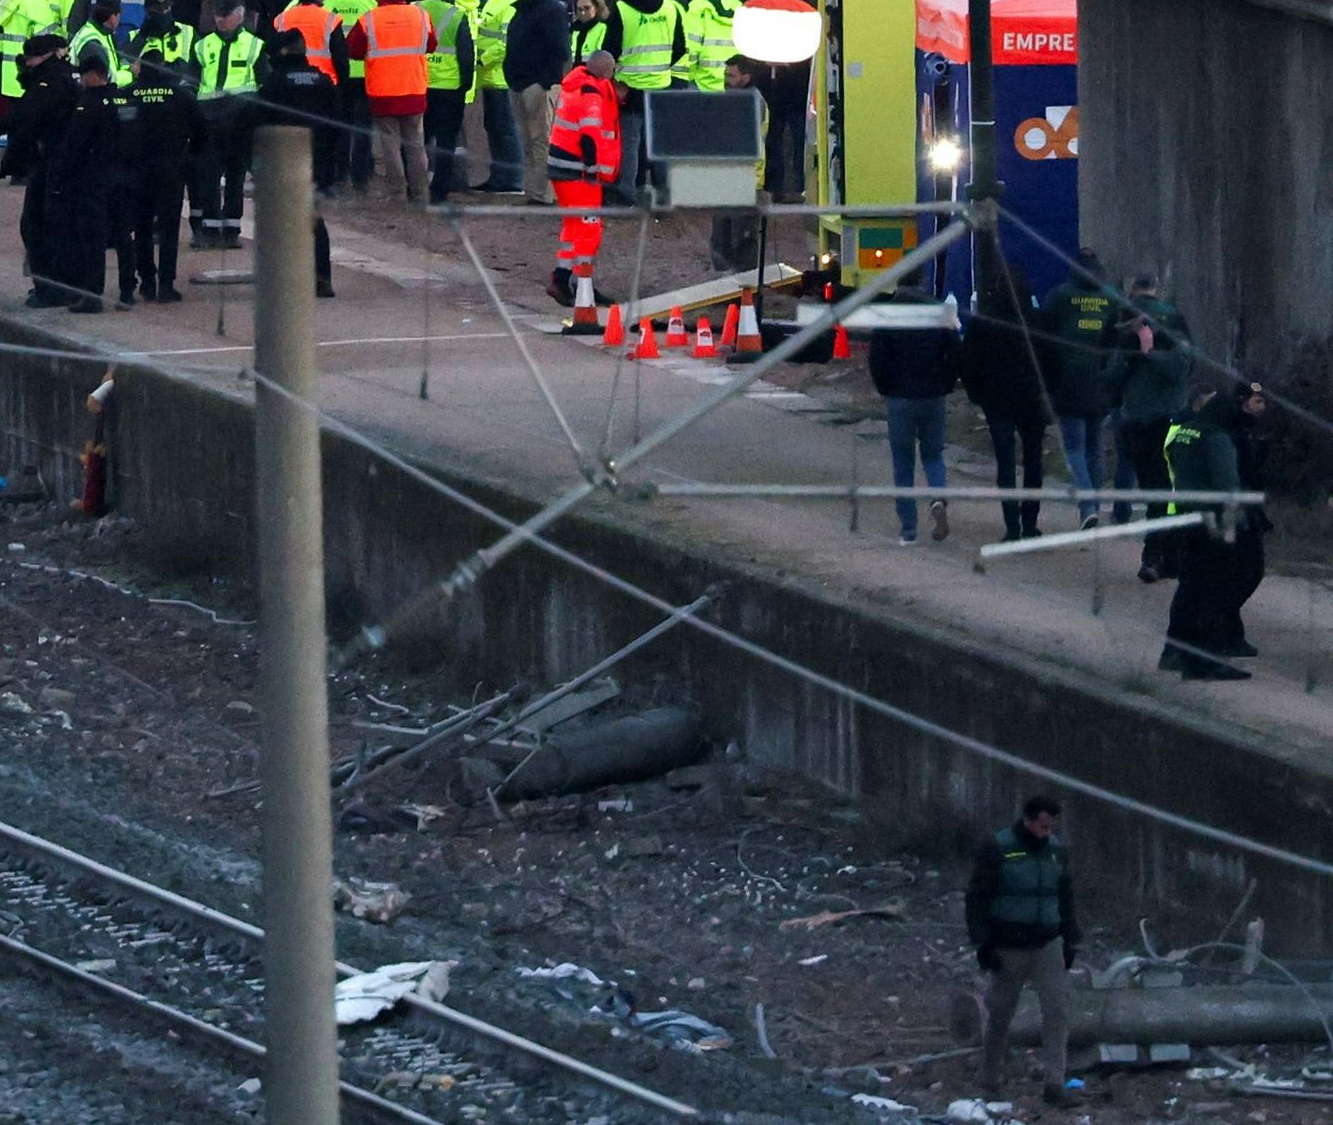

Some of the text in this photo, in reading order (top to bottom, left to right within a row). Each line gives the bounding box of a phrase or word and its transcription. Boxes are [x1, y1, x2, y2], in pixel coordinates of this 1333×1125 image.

[1003, 32, 1075, 52] EMPRE
[133, 87, 174, 97] GUARDIA
[142, 95, 165, 103] CIVIL
